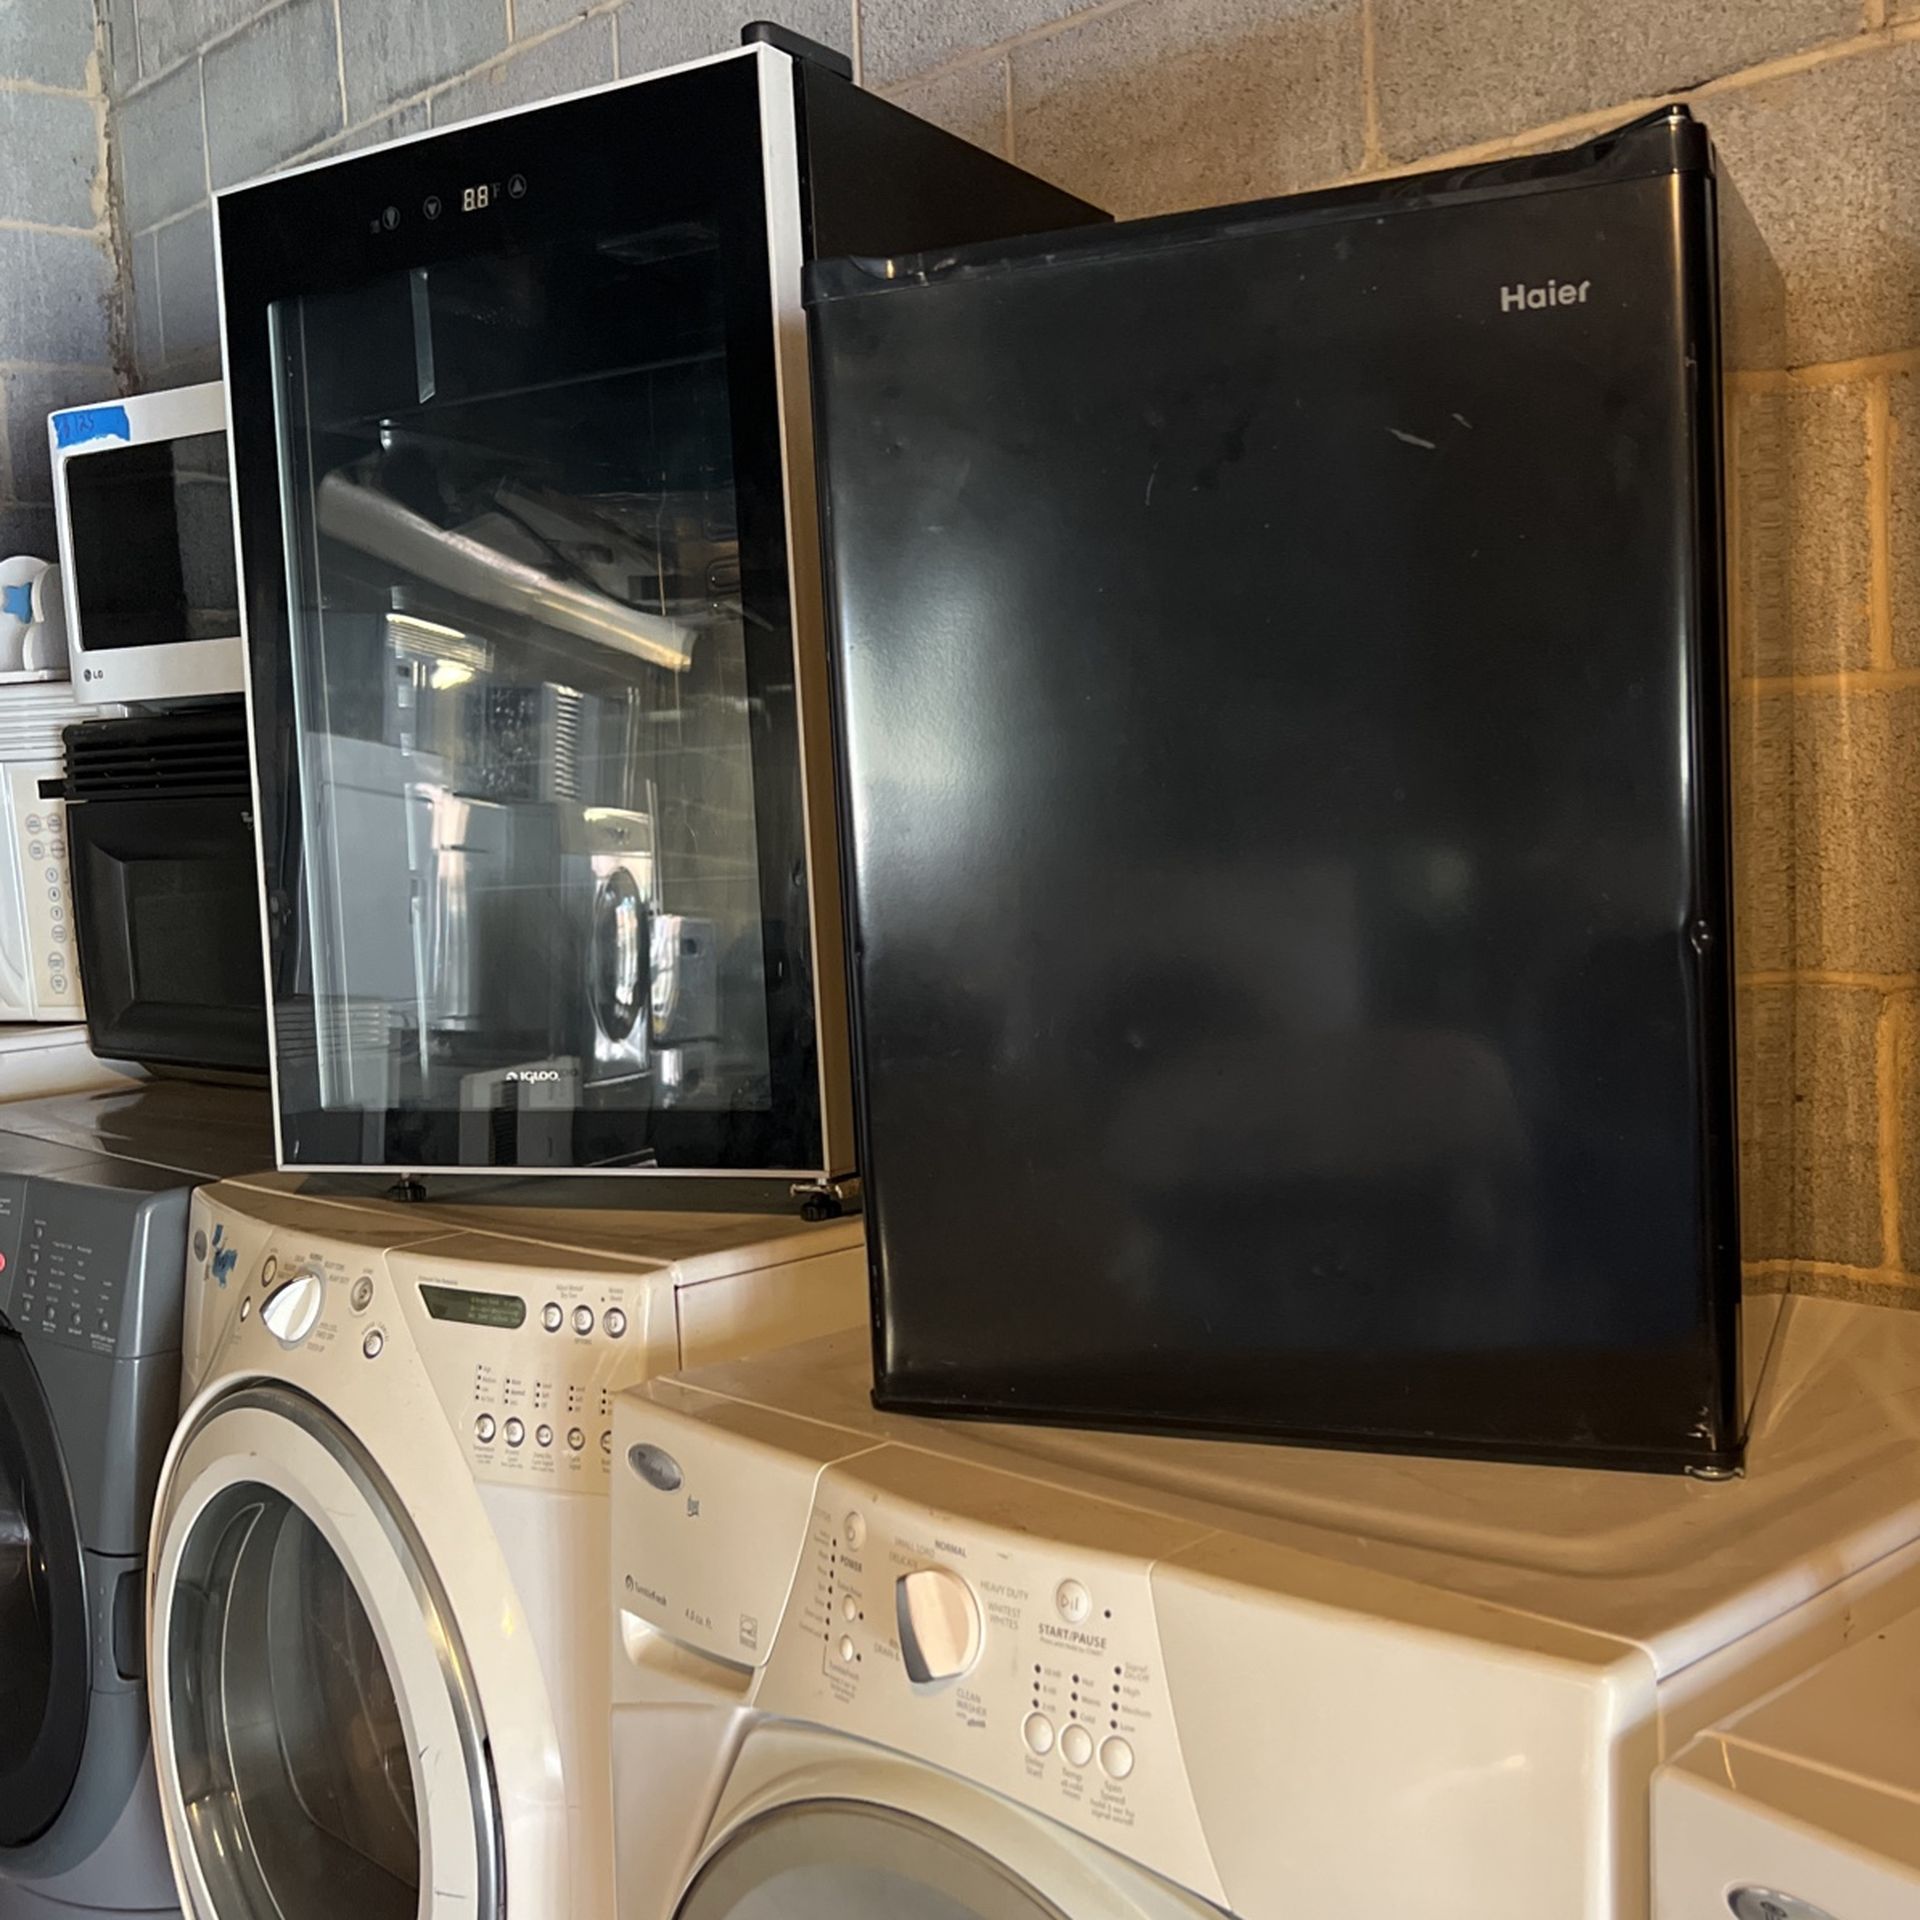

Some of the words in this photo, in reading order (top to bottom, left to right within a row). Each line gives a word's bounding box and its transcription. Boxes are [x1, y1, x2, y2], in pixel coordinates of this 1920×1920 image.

[1500, 279, 1591, 312] Haier
[93, 669, 103, 679] LG
[935, 1540, 967, 1558] NORMAL
[841, 1554, 862, 1573] POWER
[1006, 1586, 1029, 1600] DUTY
[1038, 1623, 1107, 1649] START/PAUSE
[956, 1687, 981, 1704] CLEAN
